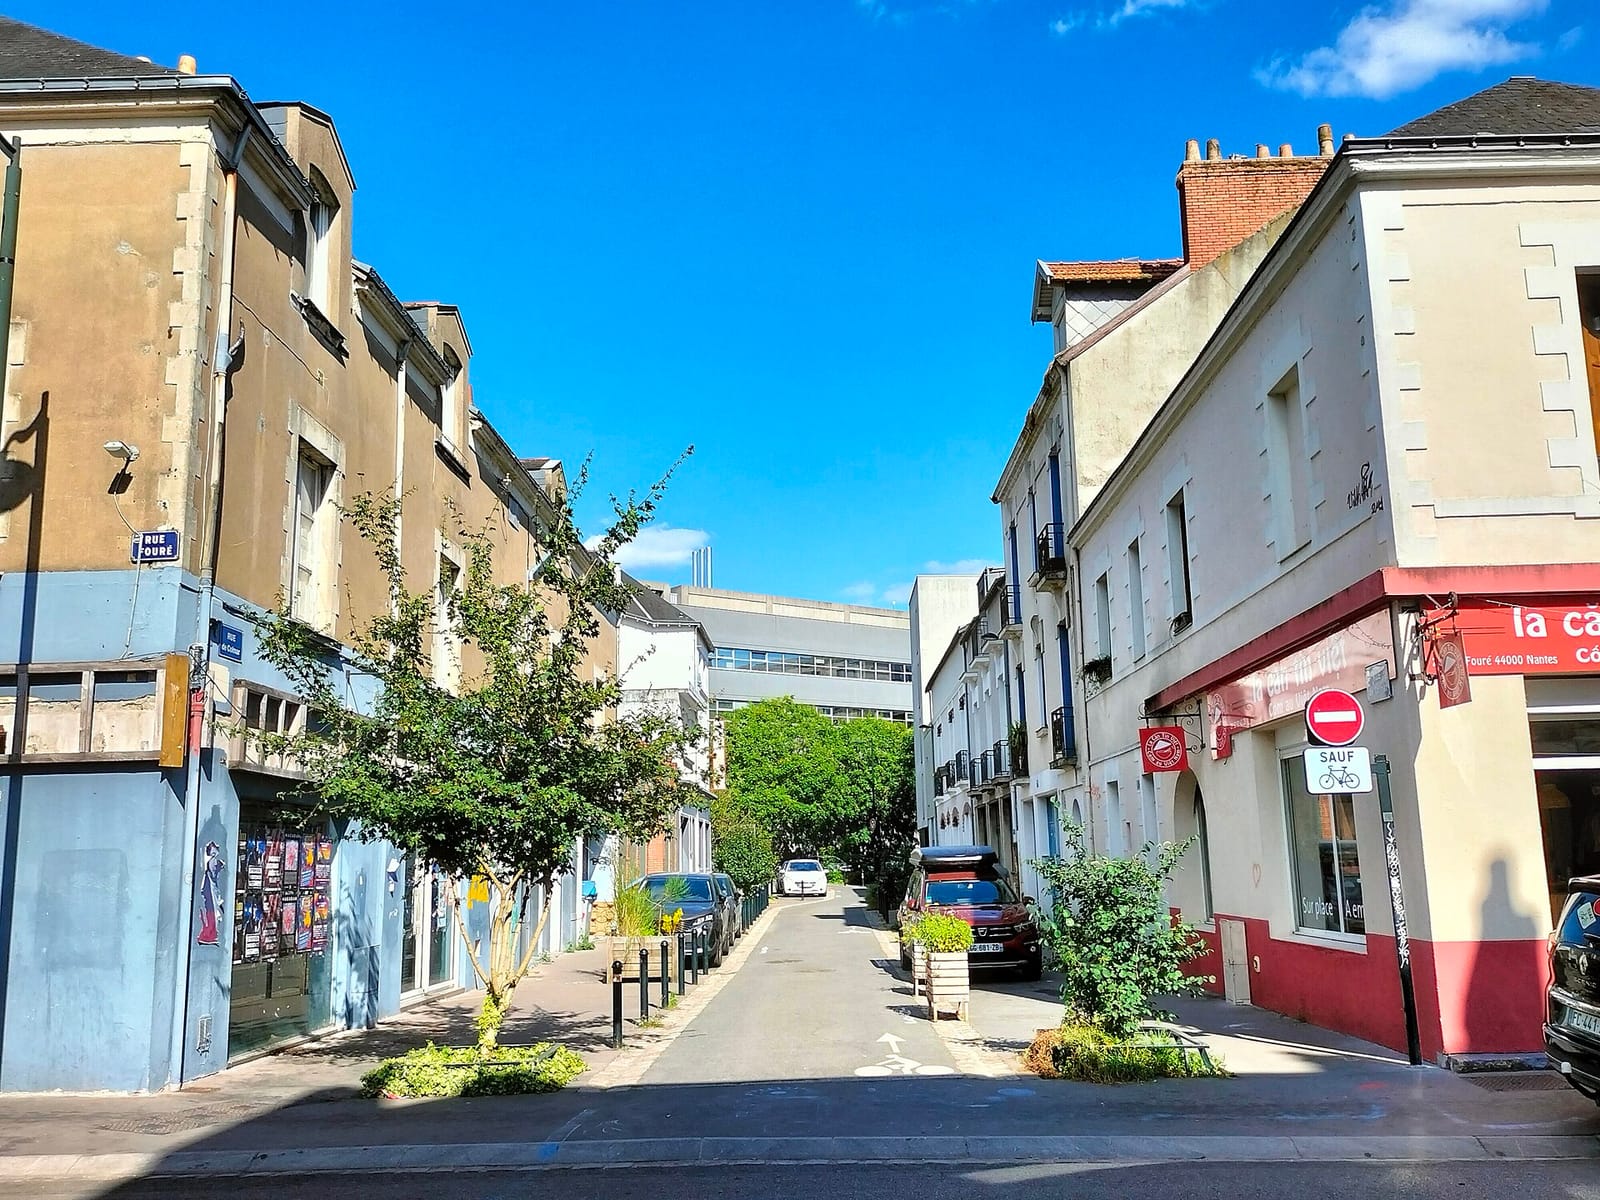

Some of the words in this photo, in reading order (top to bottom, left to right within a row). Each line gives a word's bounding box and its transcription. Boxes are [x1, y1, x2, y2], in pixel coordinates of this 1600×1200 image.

[144, 535, 166, 545] RUE
[1513, 606, 1548, 638] la
[226, 632, 237, 643] RUE
[1465, 654, 1492, 666] Fouré
[1494, 655, 1523, 665] 44000
[1526, 654, 1559, 665] Nantes
[1320, 750, 1355, 763] SAUF
[1302, 896, 1314, 914] Sur
[1314, 896, 1334, 920] place
[1345, 899, 1352, 918] A
